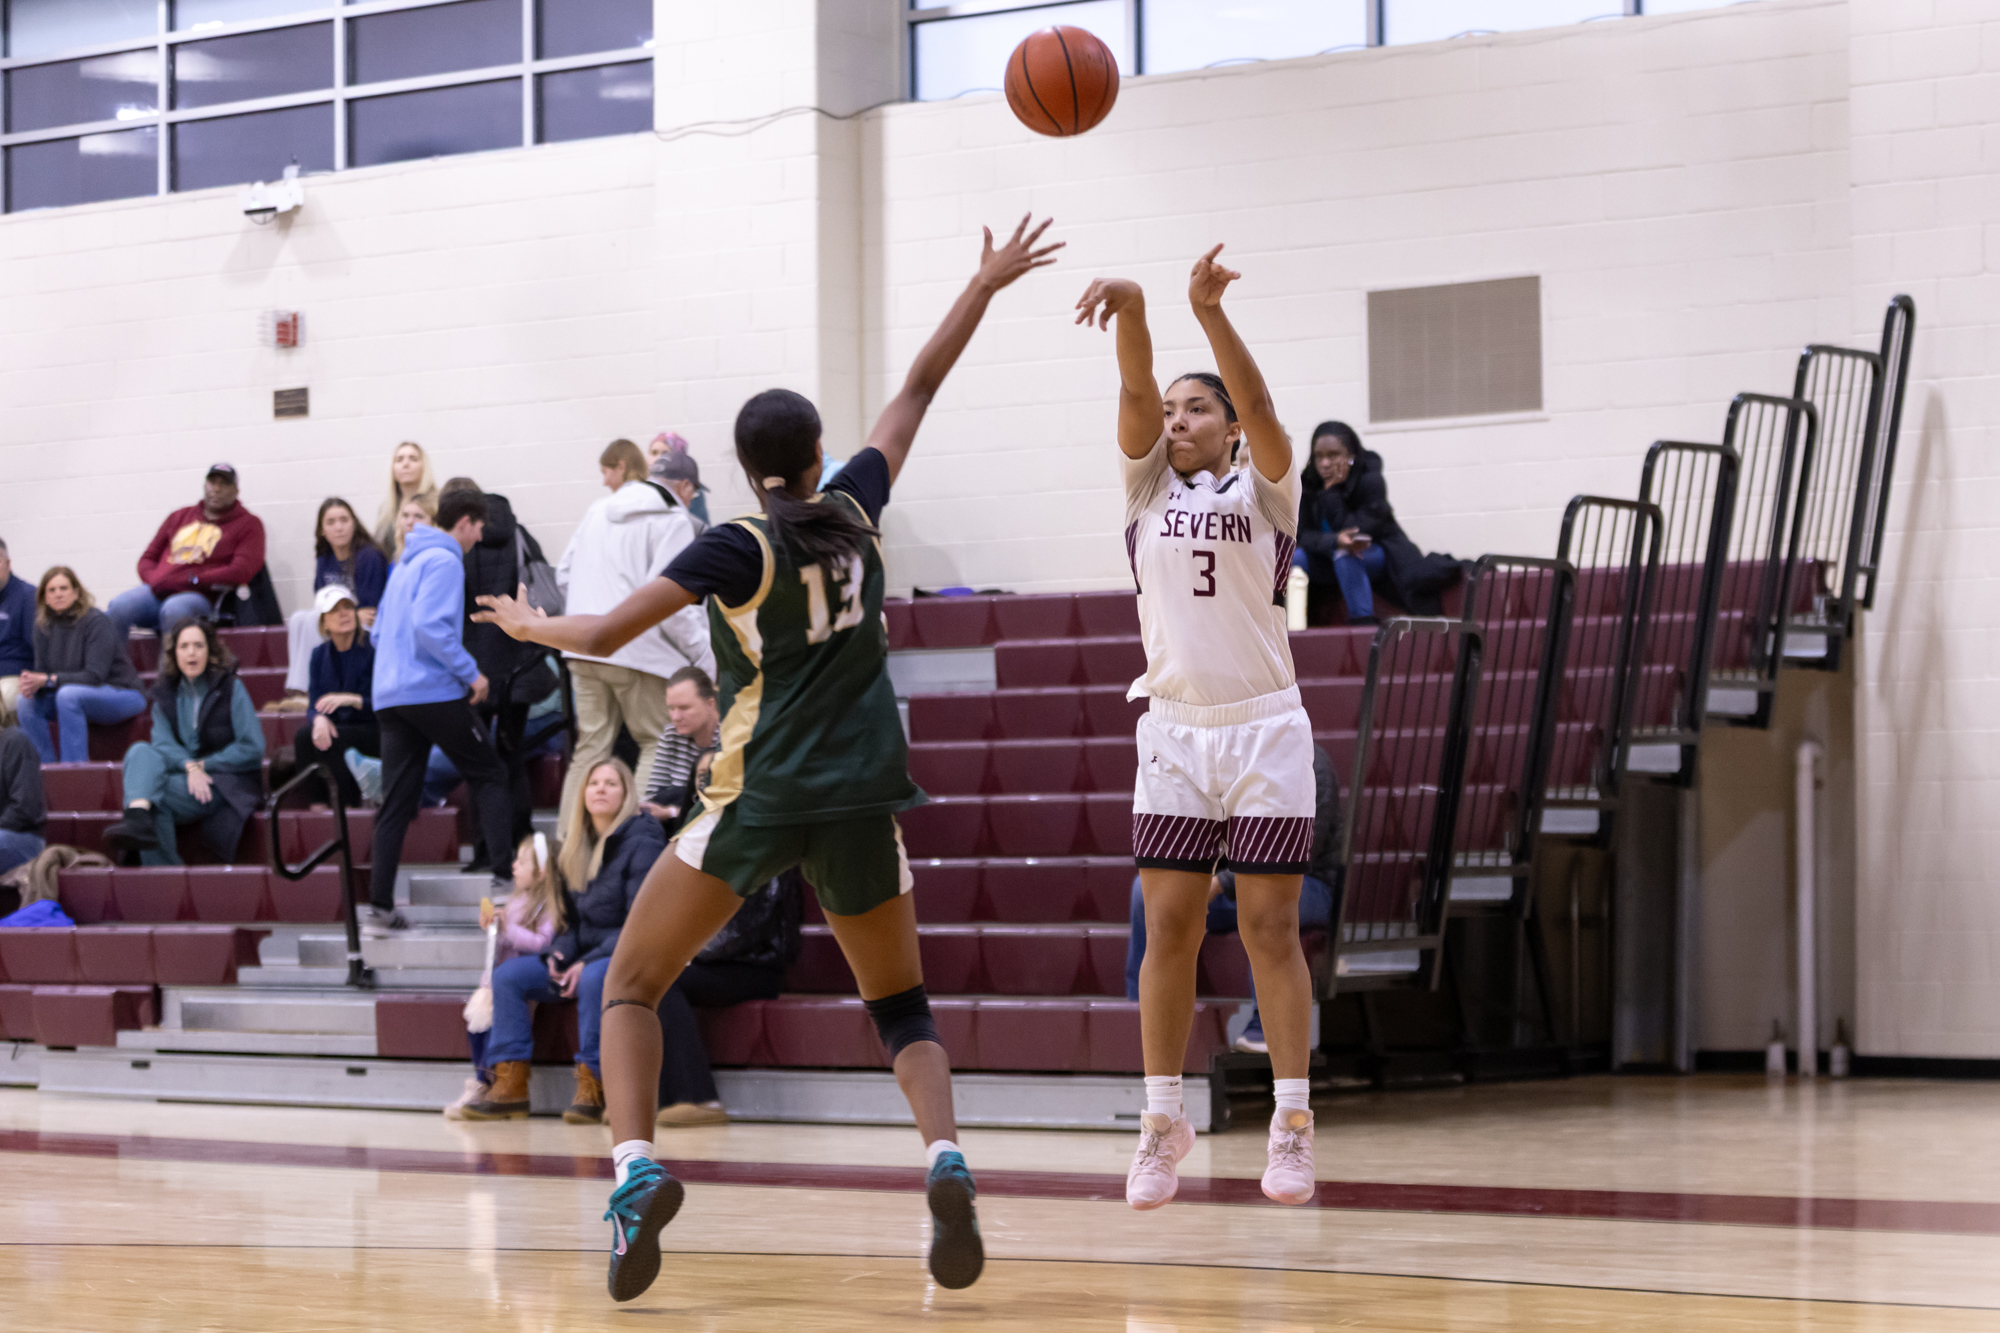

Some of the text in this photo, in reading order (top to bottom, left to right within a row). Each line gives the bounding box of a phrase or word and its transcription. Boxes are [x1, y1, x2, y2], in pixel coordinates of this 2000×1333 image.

[1160, 509, 1252, 544] SEVERN
[799, 551, 865, 645] 13
[1192, 549, 1216, 598] 3
